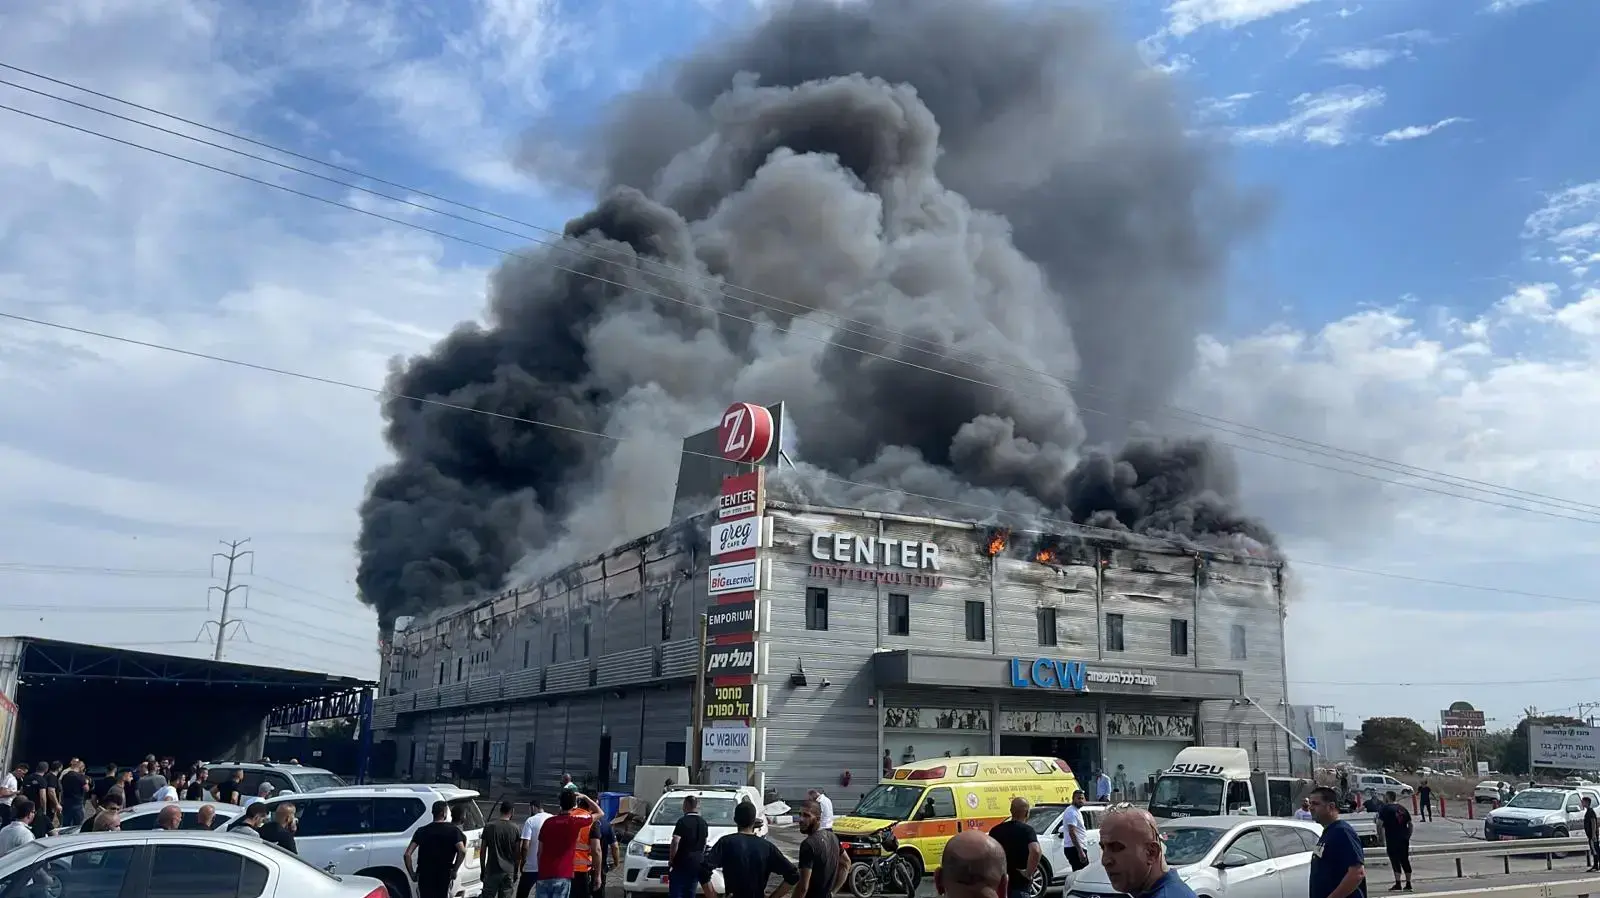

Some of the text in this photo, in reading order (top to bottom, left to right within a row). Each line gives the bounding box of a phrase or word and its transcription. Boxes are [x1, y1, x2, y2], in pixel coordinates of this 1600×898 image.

[724, 408, 747, 453] Z
[720, 489, 756, 508] CENTER
[720, 523, 752, 550] greg
[811, 531, 940, 571] CENTER
[709, 609, 753, 625] EMPORIUM
[1010, 656, 1087, 691] LCW
[1087, 670, 1157, 686] אופנה לכל המשפחה
[715, 687, 742, 700] מחסני
[707, 701, 750, 717] זול ספורט
[705, 733, 715, 746] LC
[1169, 763, 1224, 774] ISUZU
